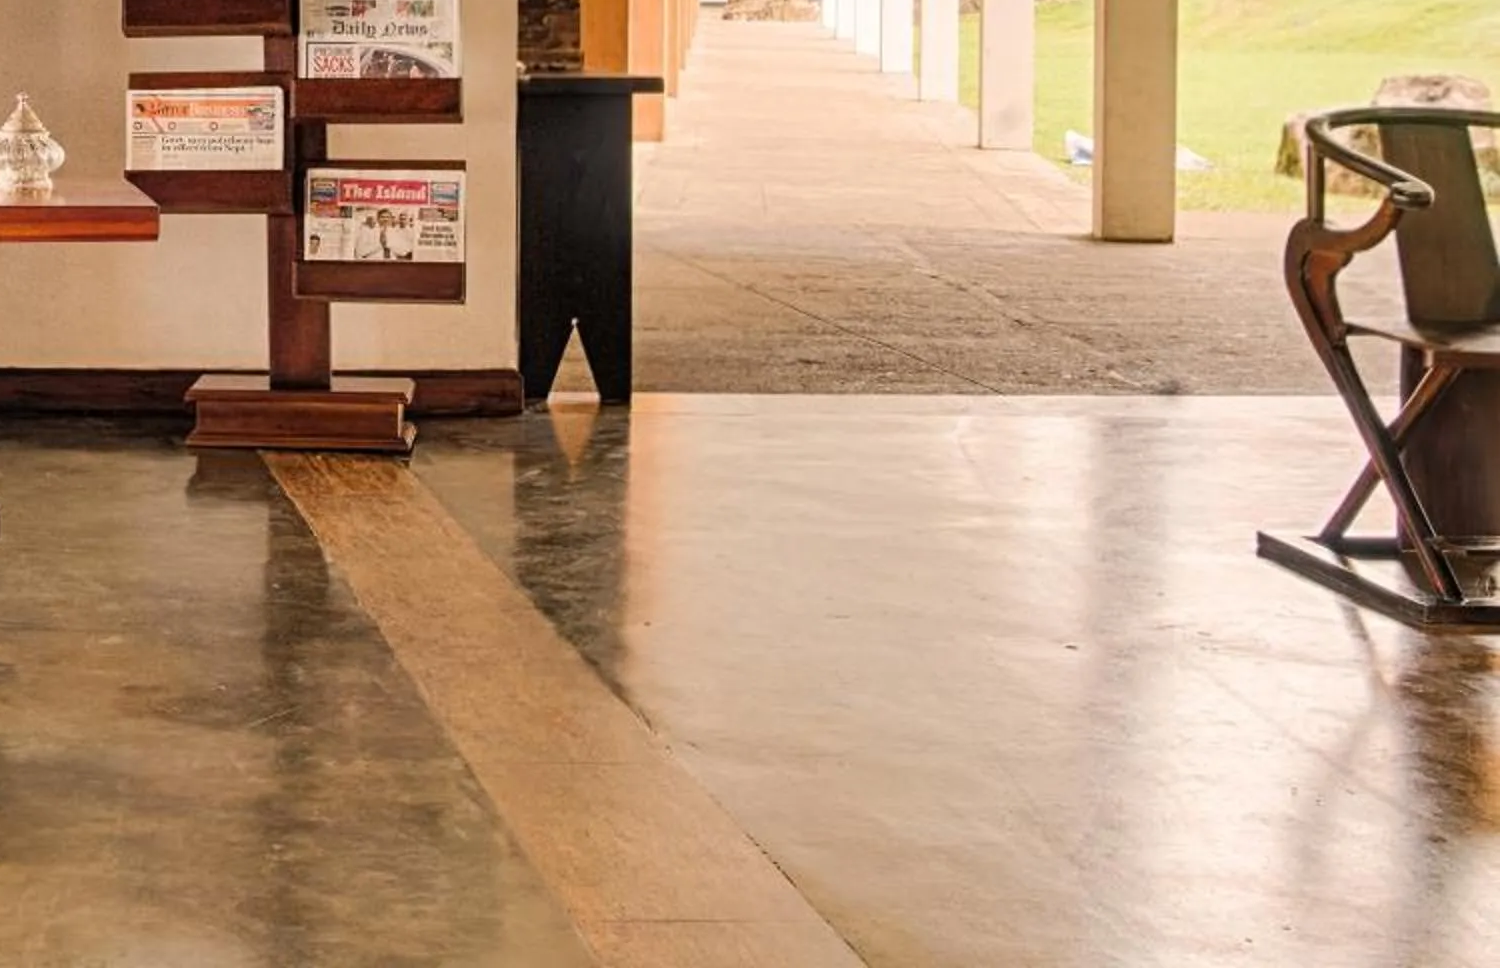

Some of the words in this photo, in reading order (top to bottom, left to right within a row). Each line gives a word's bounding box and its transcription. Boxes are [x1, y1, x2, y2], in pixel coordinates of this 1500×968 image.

[331, 19, 377, 39] Daily
[380, 21, 429, 38] News
[343, 183, 373, 199] The
[375, 184, 426, 201] Island
